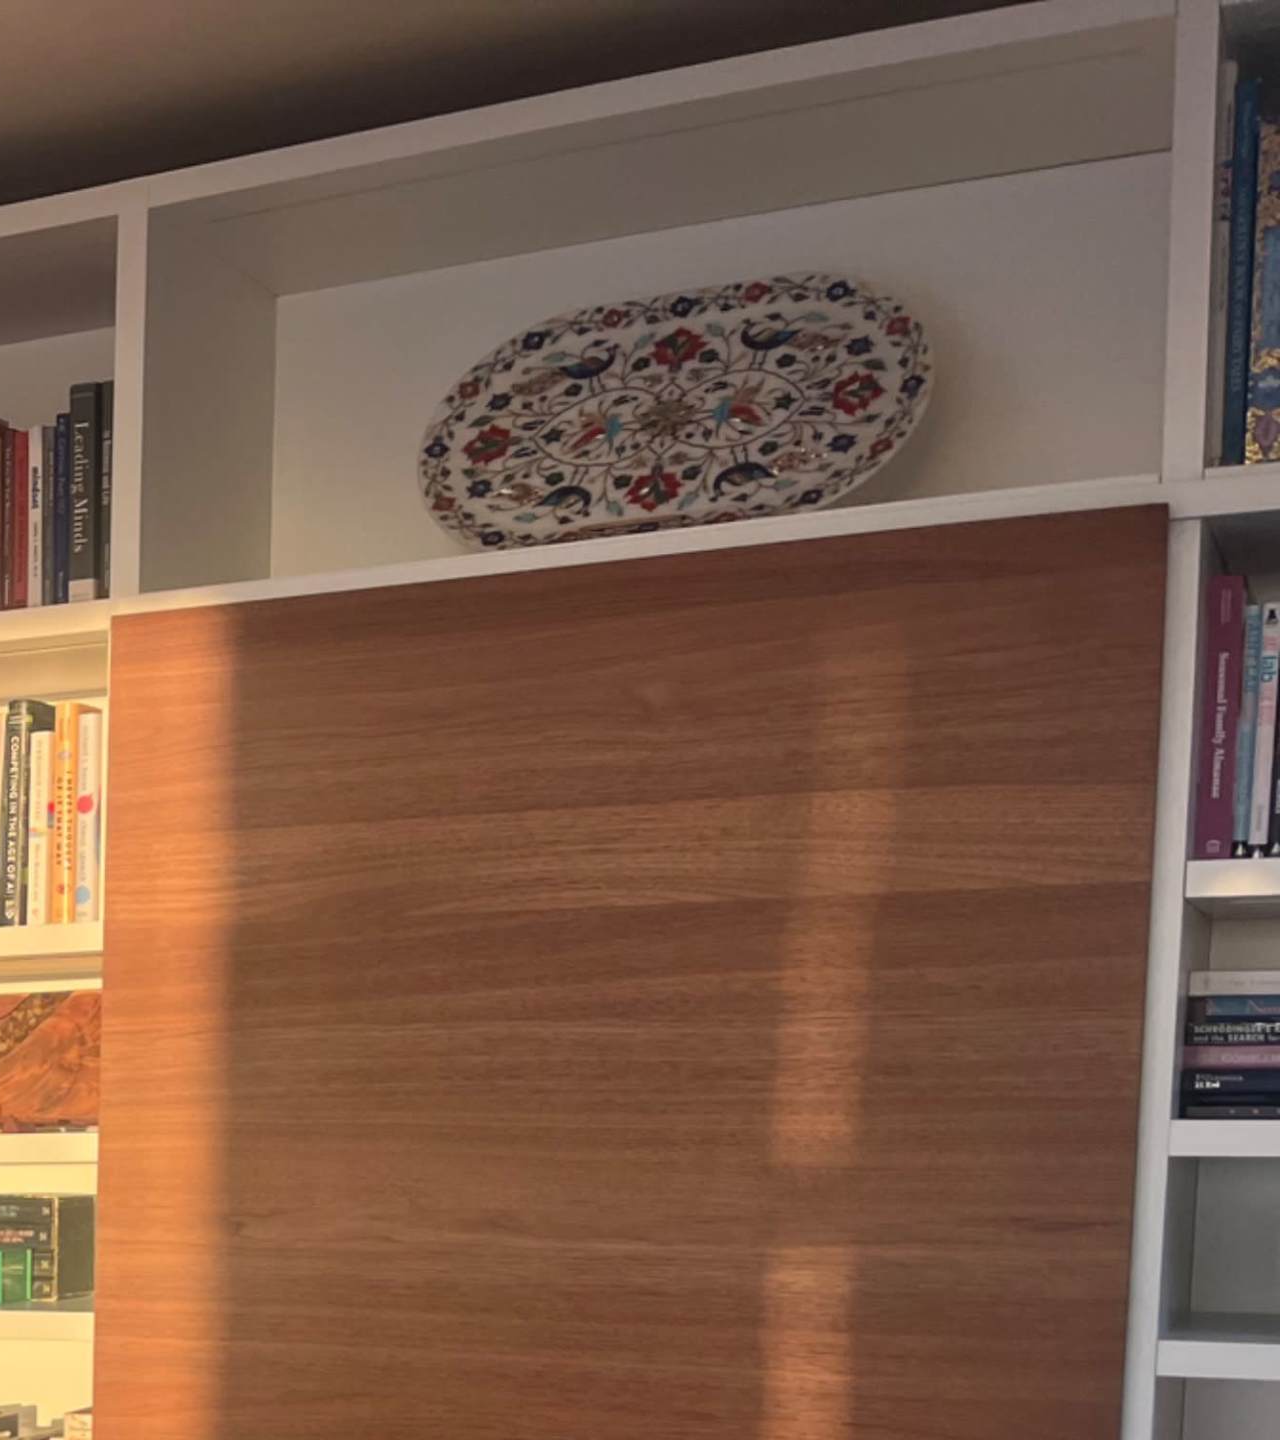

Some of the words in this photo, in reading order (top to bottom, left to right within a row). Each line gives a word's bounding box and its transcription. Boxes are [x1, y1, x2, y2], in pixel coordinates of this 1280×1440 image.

[72, 421, 90, 494] Leading
[32, 466, 40, 509] mindset
[73, 498, 88, 552] Minds
[1211, 706, 1227, 744] Family
[8, 736, 20, 798] COMPETING
[1211, 748, 1224, 799] Almanac
[8, 801, 18, 814] IN
[8, 816, 17, 838] THE
[7, 840, 16, 862] AGE
[6, 864, 16, 878] OF
[6, 882, 15, 893] AI
